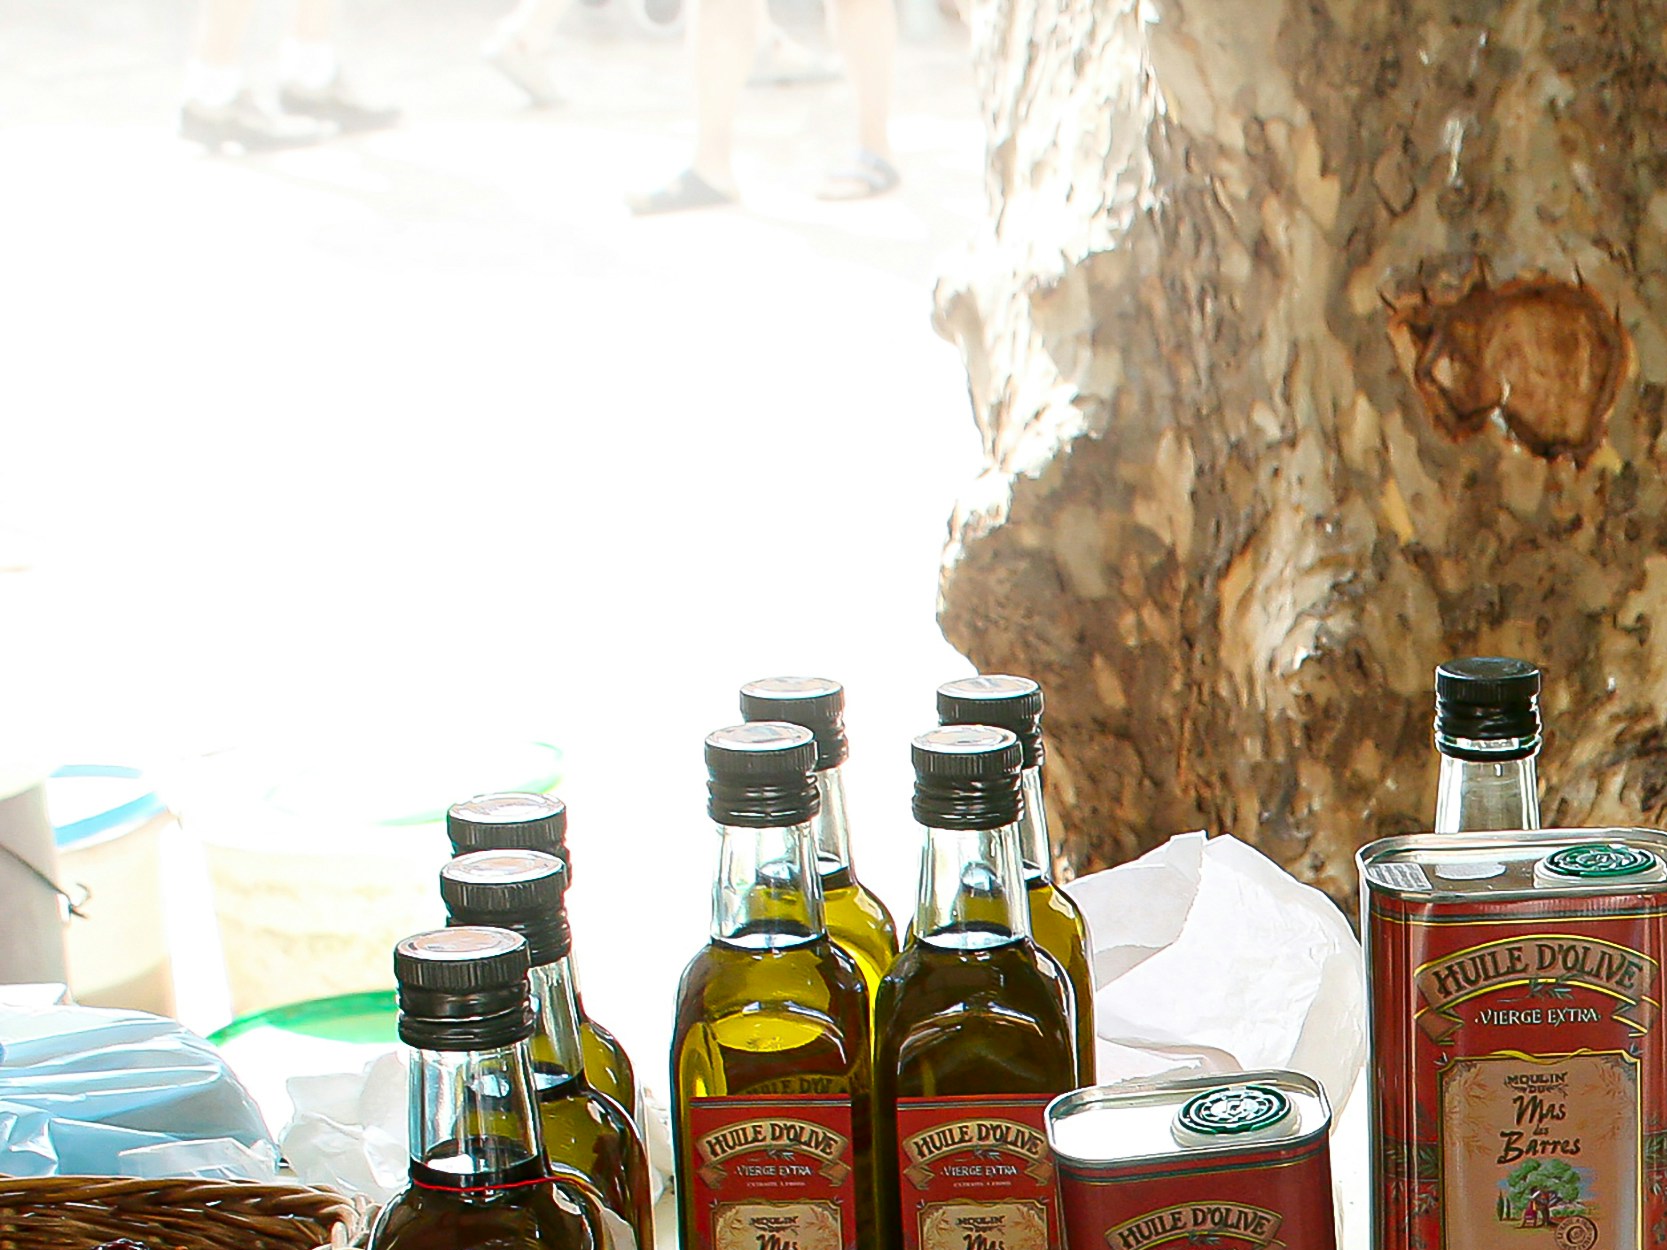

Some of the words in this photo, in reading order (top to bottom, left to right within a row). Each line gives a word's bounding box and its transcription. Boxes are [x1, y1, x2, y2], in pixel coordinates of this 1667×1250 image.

[1432, 946, 1528, 998] HUILE
[1535, 943, 1644, 989] D'OLIVE
[1479, 1009, 1542, 1026] VIERGE
[1547, 1008, 1599, 1027] EXTRA
[1512, 1095, 1566, 1127] Mas
[705, 1124, 767, 1158] HUILE
[769, 1123, 838, 1156] D'OLIVE
[913, 1125, 974, 1159] HUILE
[976, 1123, 1045, 1155] D'OLIVE
[1496, 1131, 1582, 1165] Barres
[1118, 1210, 1190, 1250] HUILE
[1192, 1206, 1273, 1236] D'OLIVE
